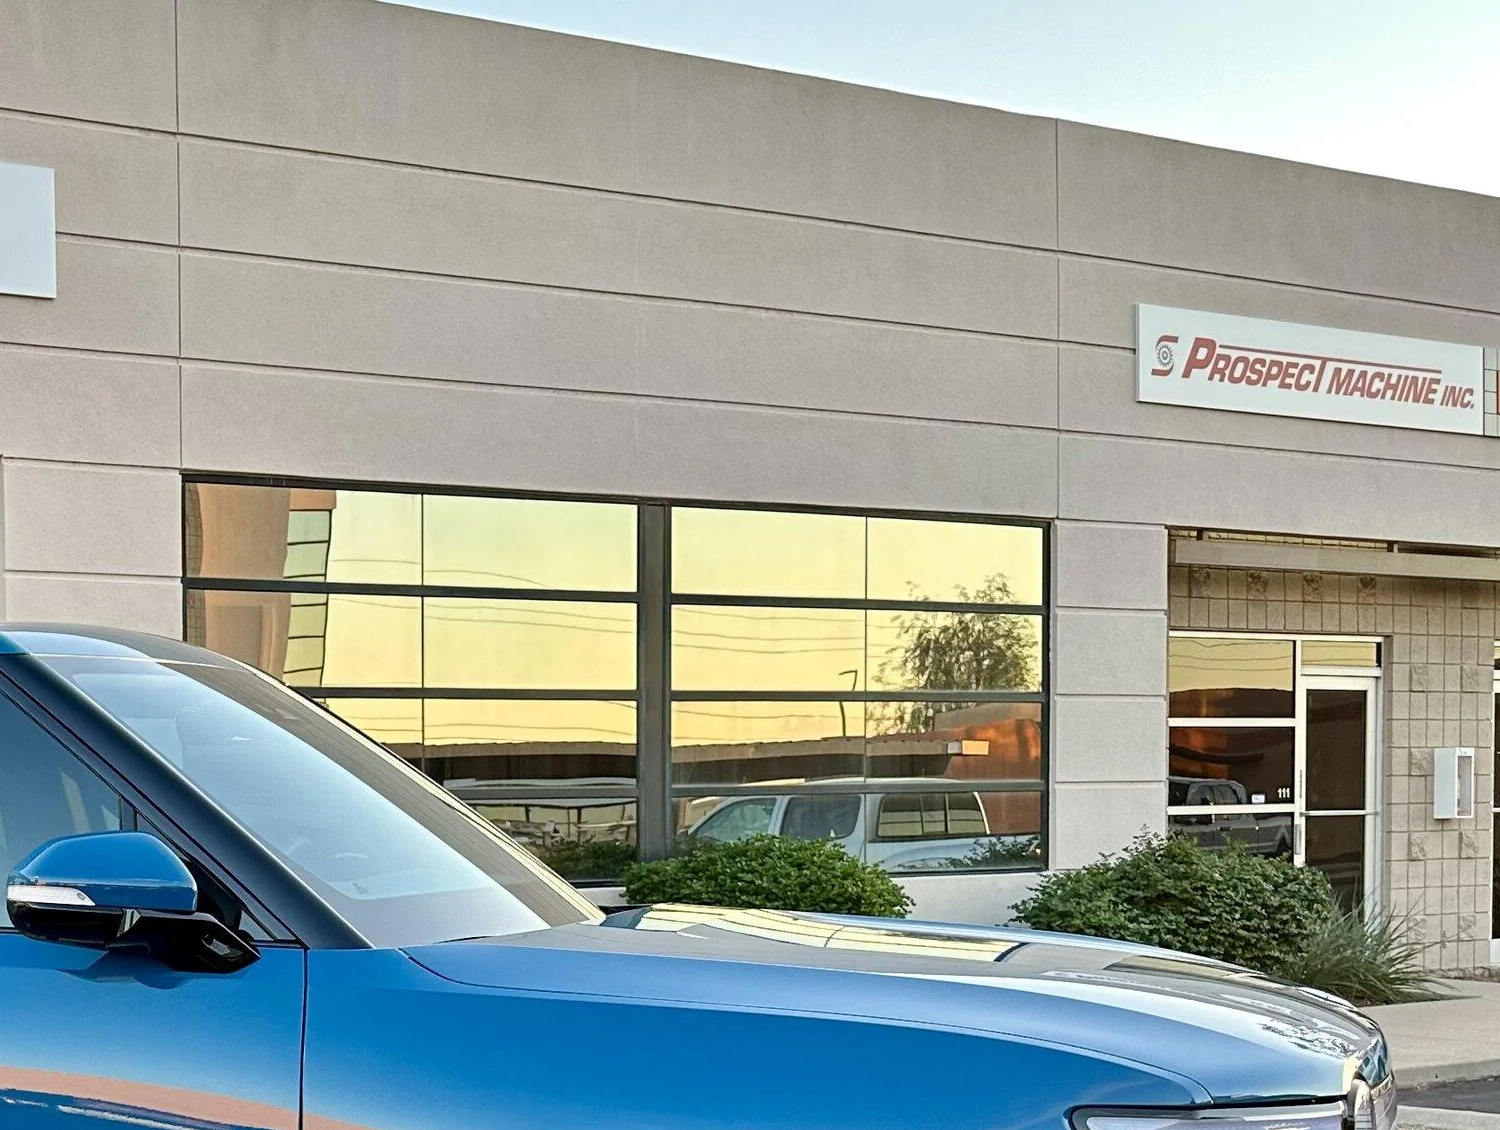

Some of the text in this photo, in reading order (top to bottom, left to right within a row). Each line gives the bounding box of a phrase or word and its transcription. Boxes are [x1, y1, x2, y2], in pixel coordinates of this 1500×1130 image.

[1181, 336, 1475, 410] PROSPECT MACHINE INC.
[1277, 787, 1291, 799] 111
